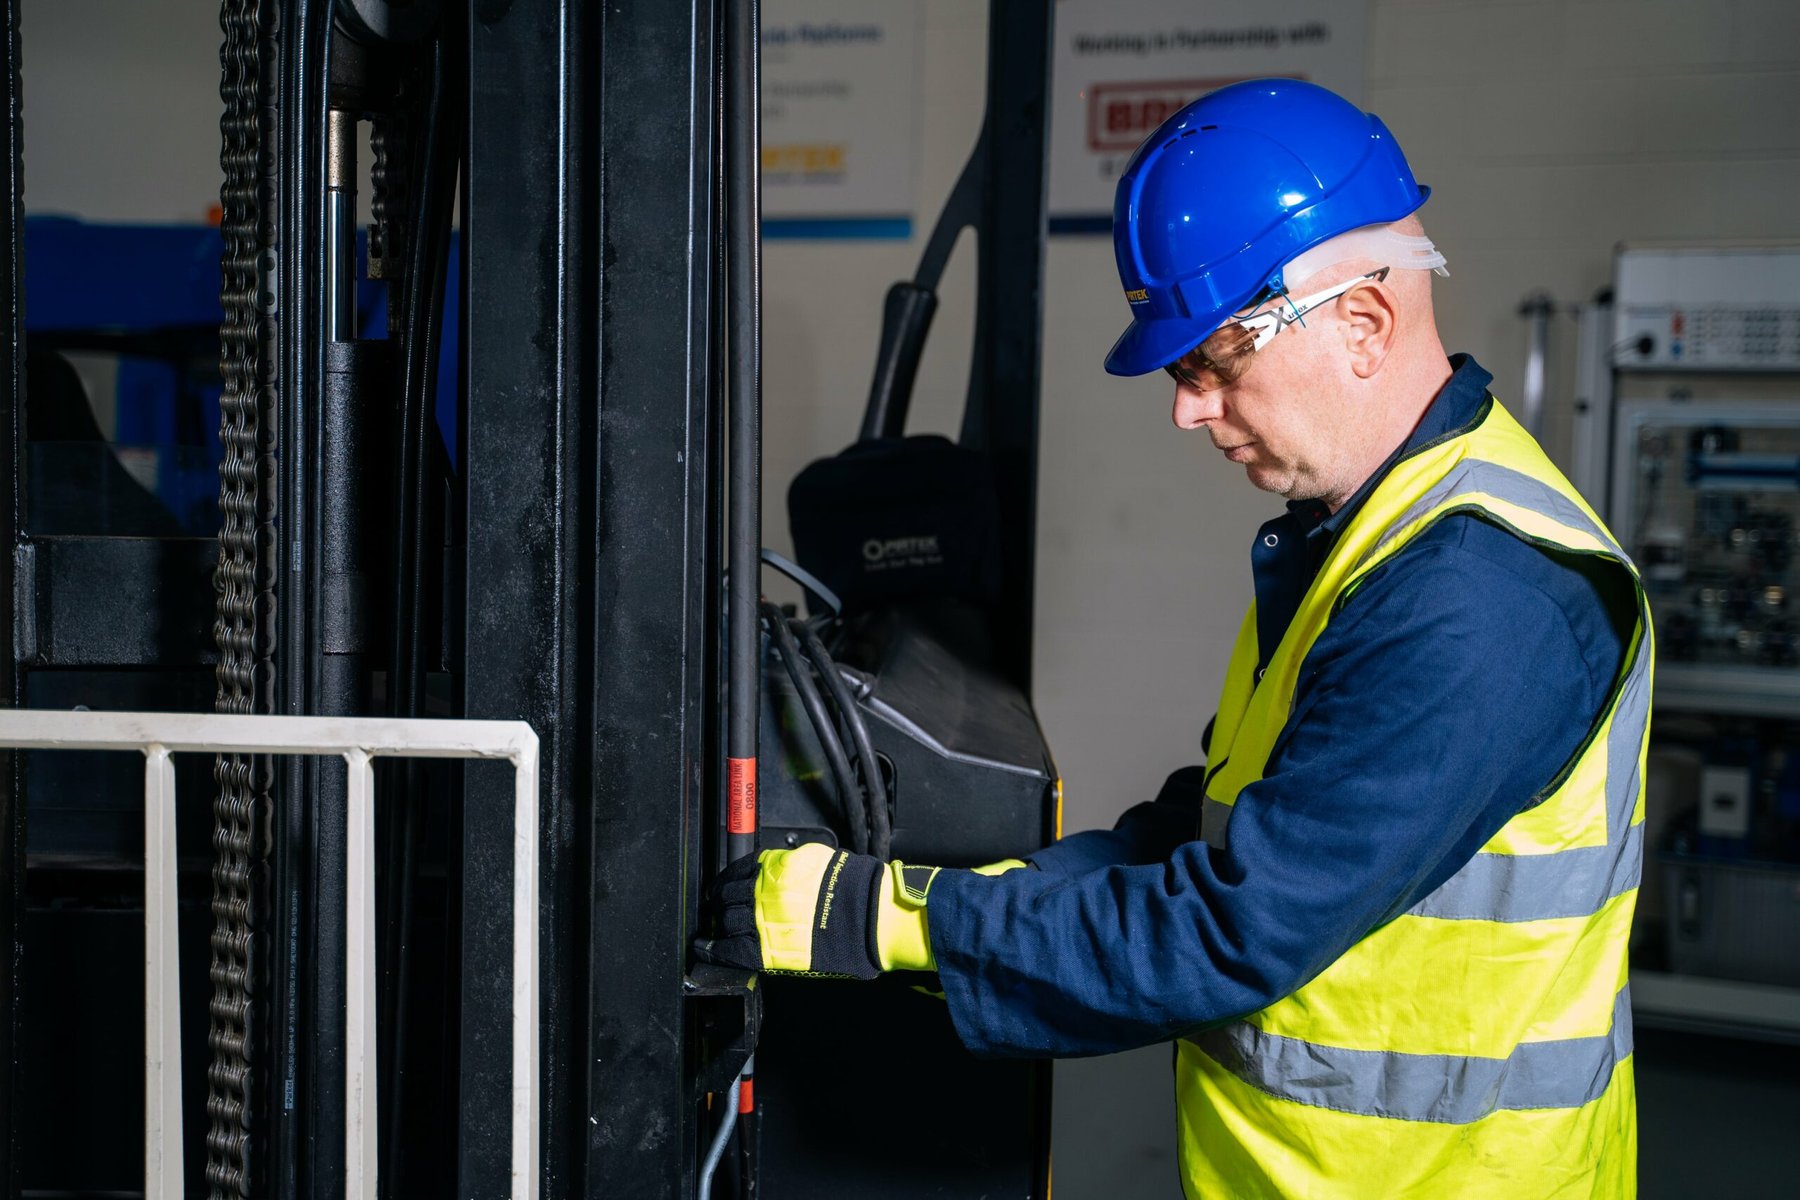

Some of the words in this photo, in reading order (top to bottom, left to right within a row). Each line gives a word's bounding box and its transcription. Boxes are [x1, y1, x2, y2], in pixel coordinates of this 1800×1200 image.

[733, 762, 743, 779] LINK
[733, 779, 743, 797] AREA
[745, 782, 754, 810] 0800
[732, 798, 743, 831] NATIONAL
[828, 862, 844, 891] Injection
[820, 892, 834, 929] Resistant
